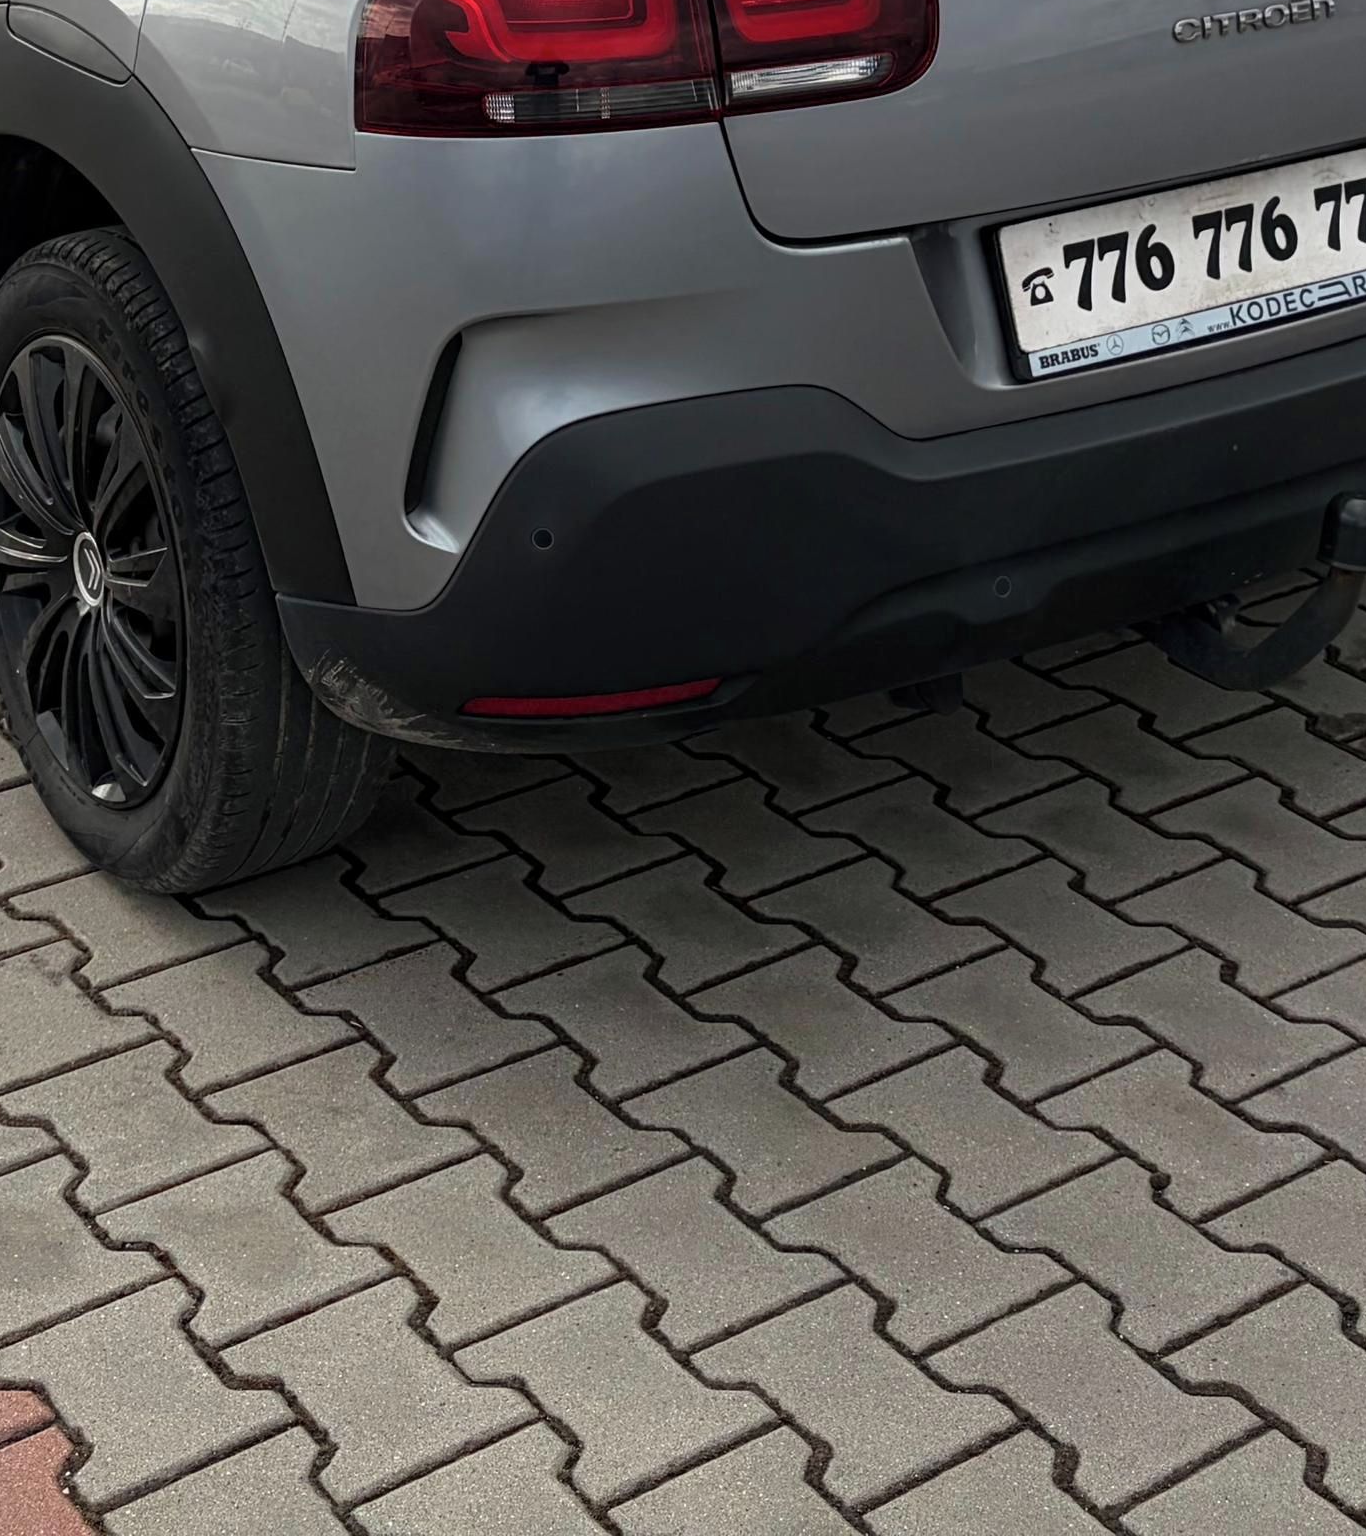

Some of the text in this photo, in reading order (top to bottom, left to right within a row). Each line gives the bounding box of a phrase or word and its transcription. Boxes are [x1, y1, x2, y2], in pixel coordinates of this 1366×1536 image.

[1063, 223, 1175, 312] 776
[1192, 195, 1299, 280] 776
[1038, 343, 1100, 370] BRABUS
